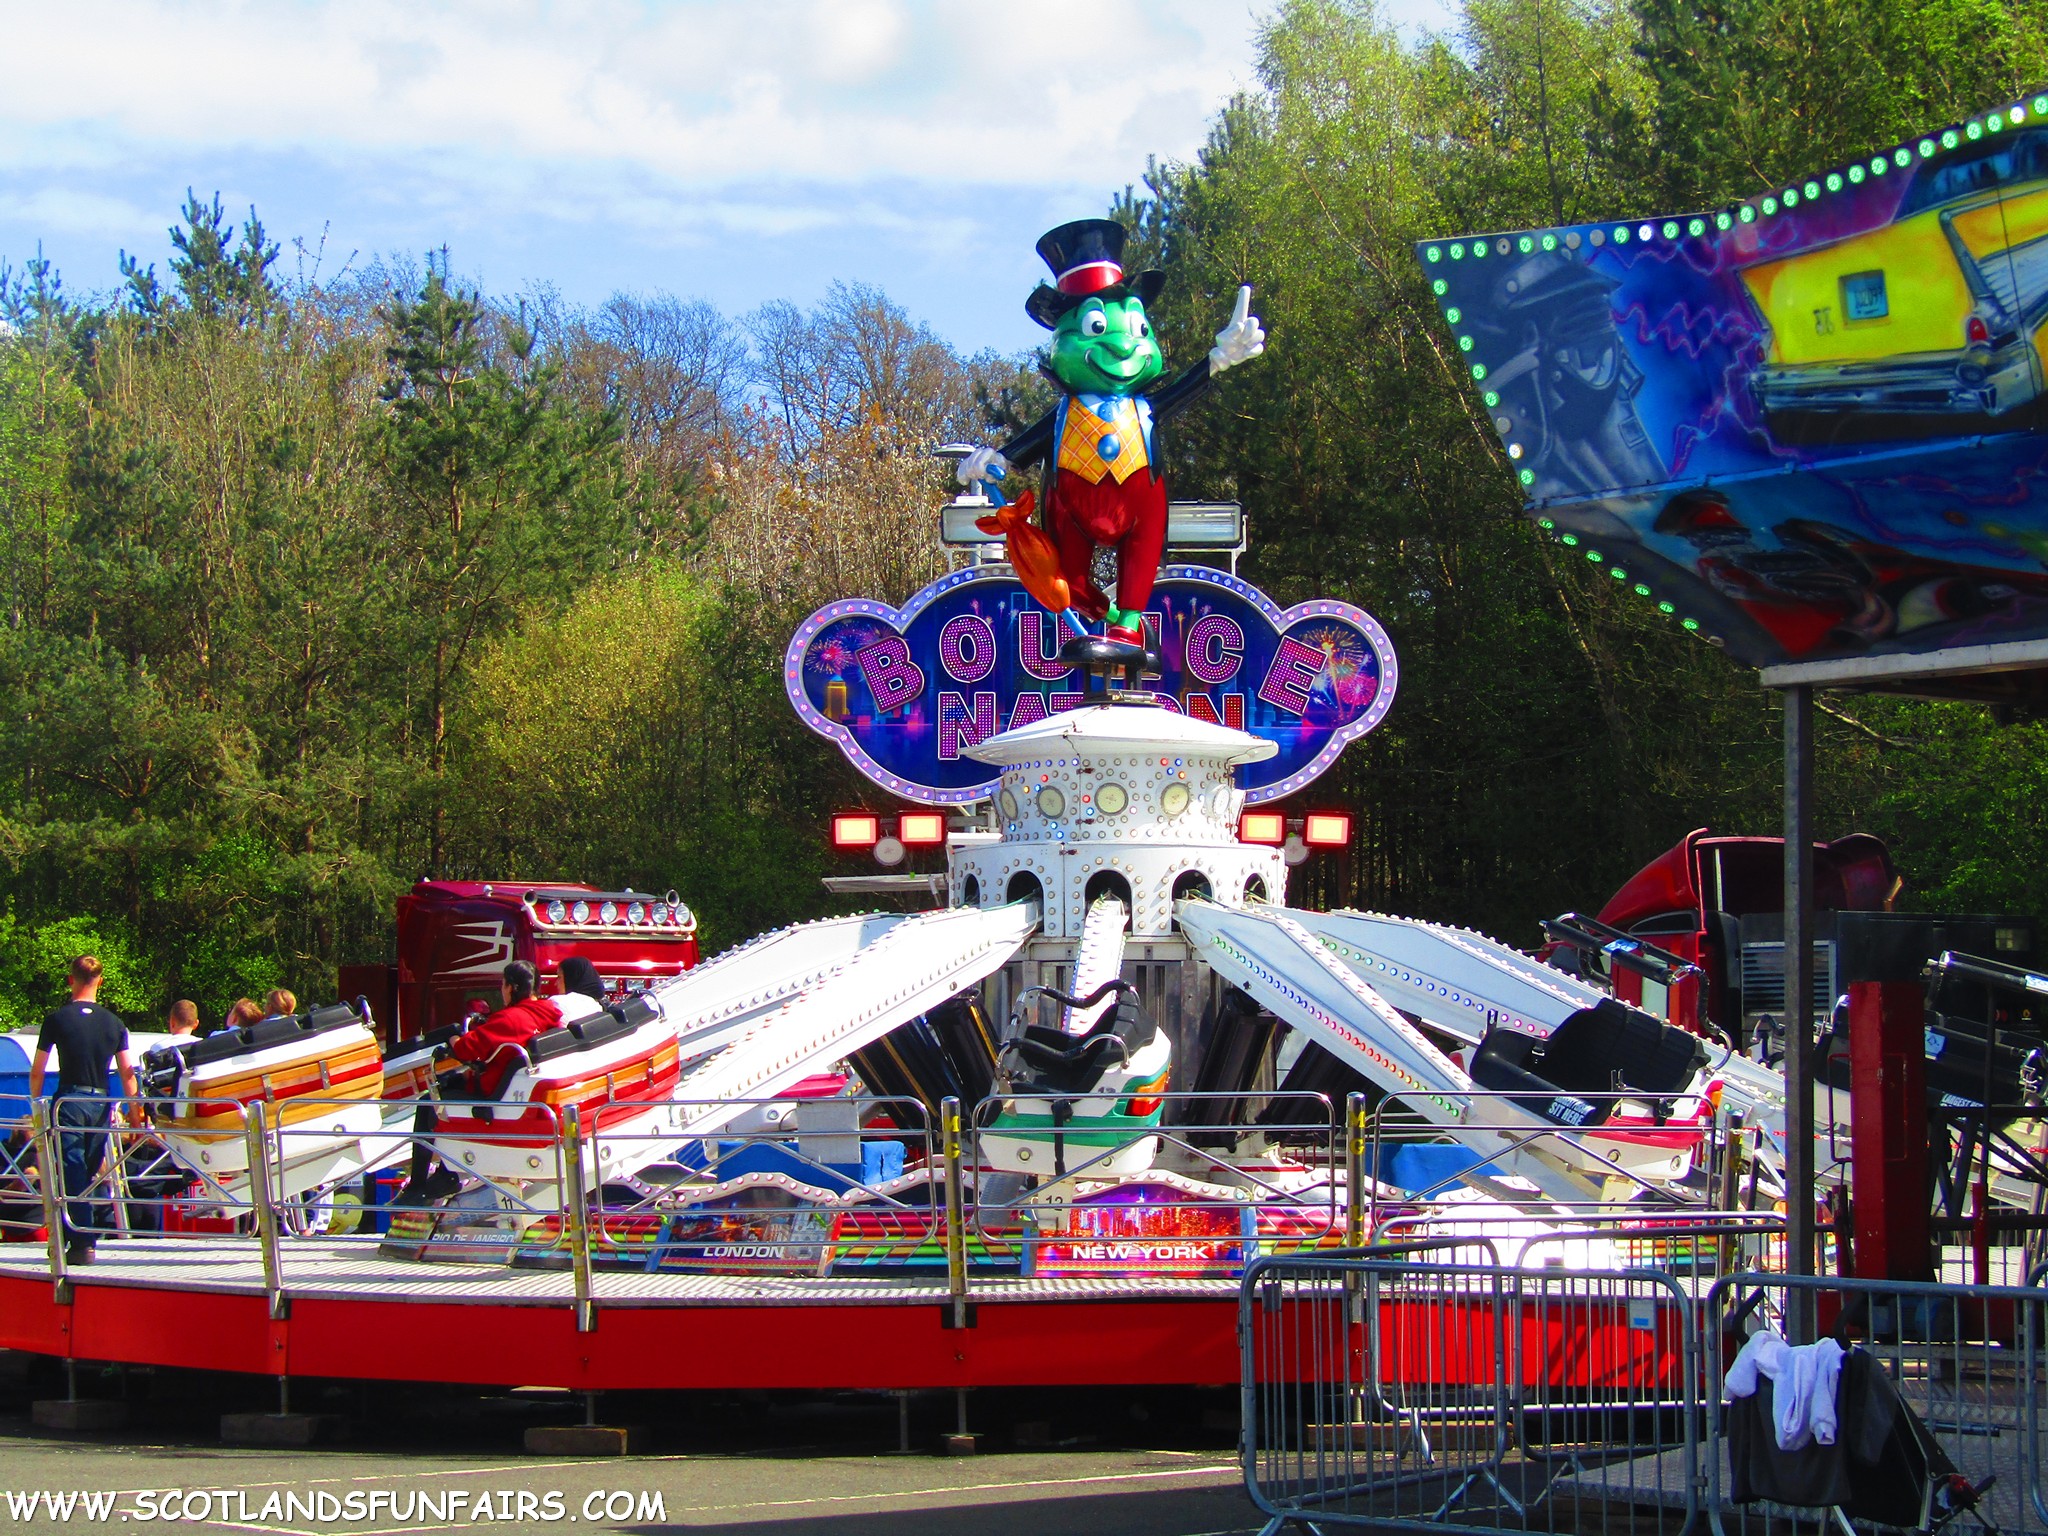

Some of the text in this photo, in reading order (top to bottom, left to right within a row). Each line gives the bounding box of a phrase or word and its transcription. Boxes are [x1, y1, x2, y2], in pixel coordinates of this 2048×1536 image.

[1548, 1101, 1566, 1117] SIT
[703, 1245, 784, 1258] LONDON
[1072, 1246, 1209, 1259] NEW YORK
